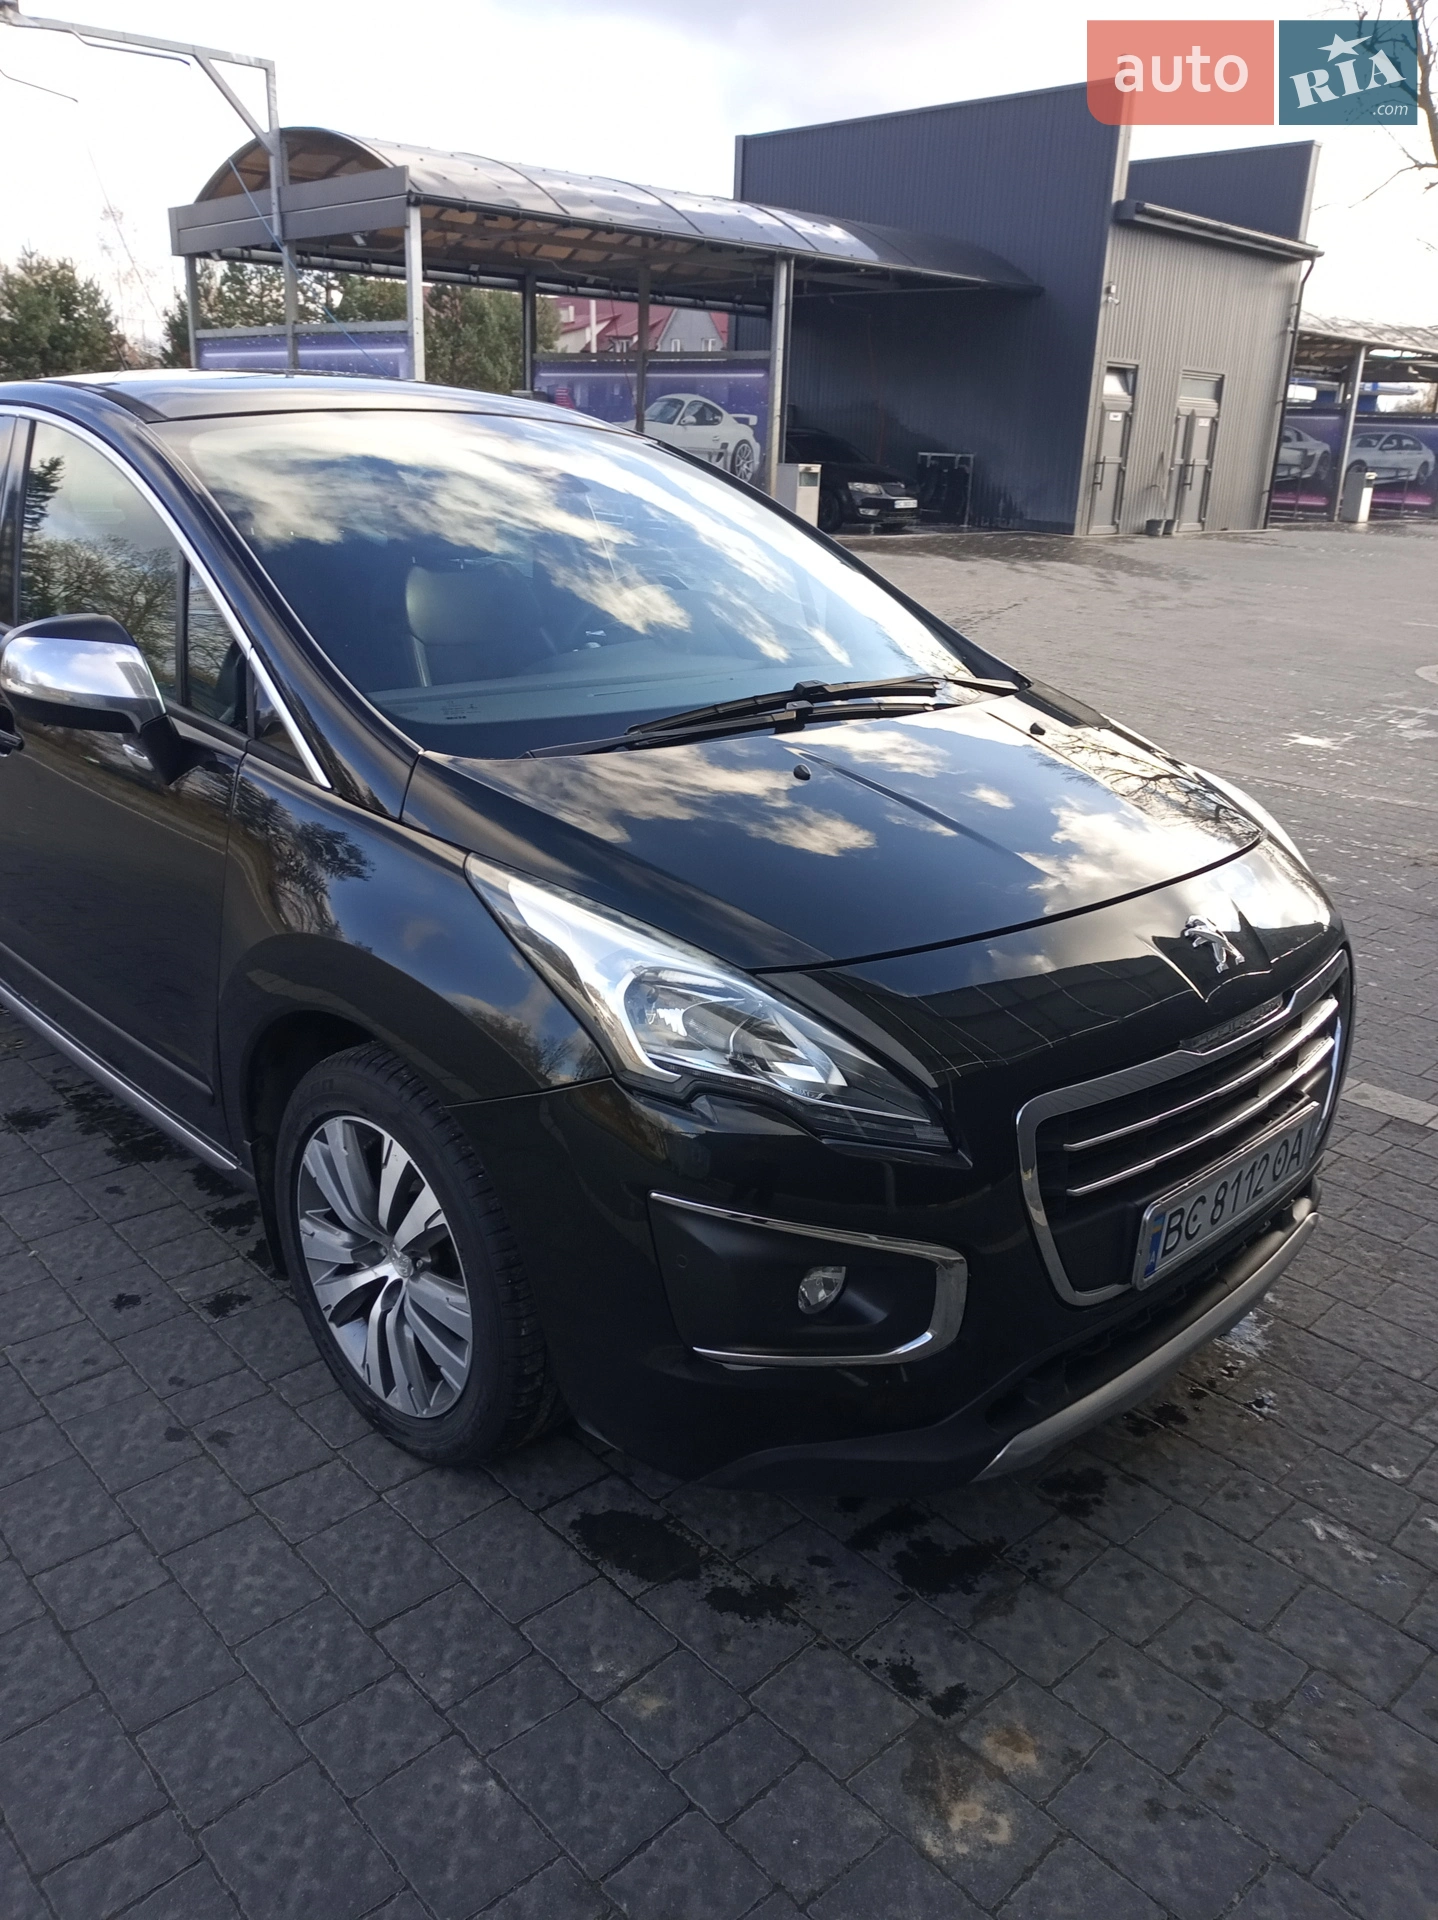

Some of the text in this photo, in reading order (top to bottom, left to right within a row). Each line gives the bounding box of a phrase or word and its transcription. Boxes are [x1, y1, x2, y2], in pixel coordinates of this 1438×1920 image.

[1160, 1128, 1304, 1259] BC 8112 OA
